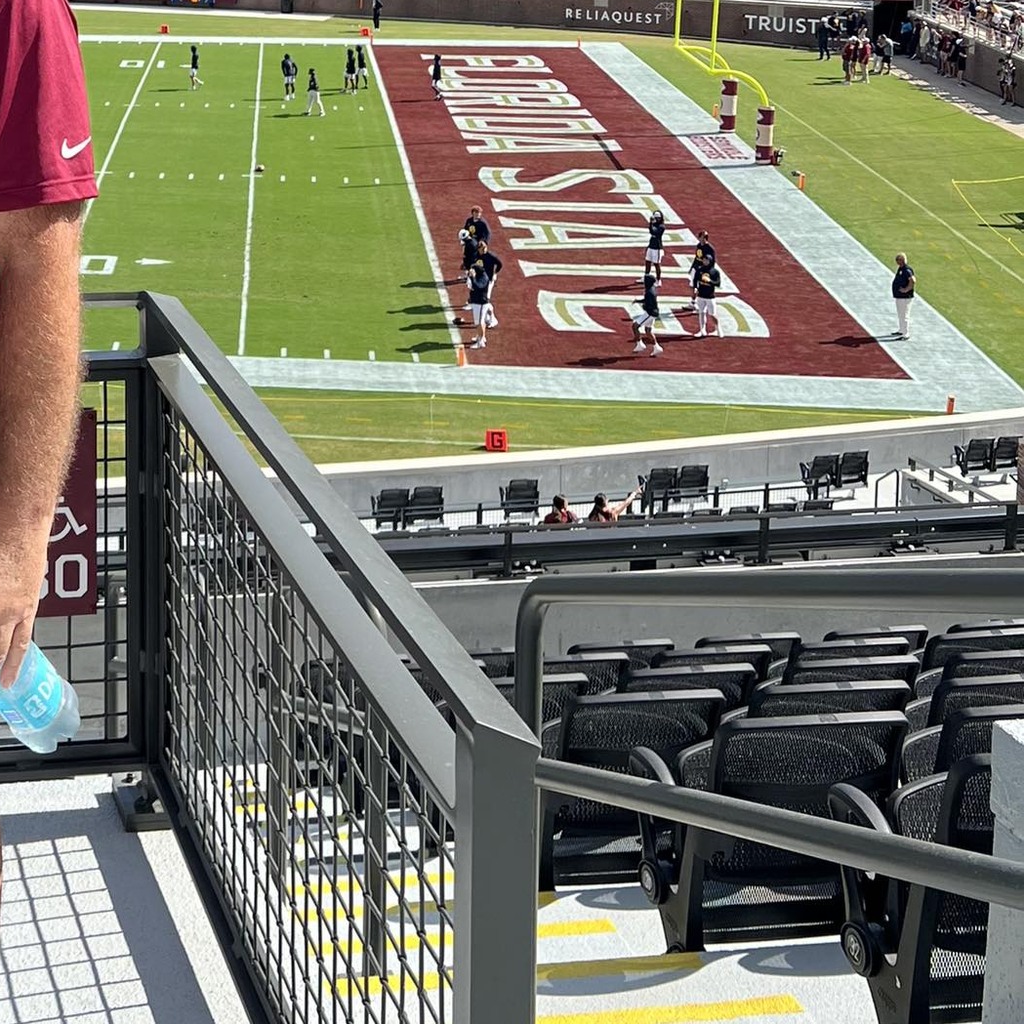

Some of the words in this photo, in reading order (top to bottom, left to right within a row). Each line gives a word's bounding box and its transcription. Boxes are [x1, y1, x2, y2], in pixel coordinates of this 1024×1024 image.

[565, 7, 662, 25] RELIAQUEST
[745, 14, 821, 36] TRUIST
[420, 54, 624, 154] FLORIDA
[478, 166, 770, 338] STATE
[79, 255, 118, 275] 0
[491, 431, 504, 449] G
[39, 553, 89, 599] 0
